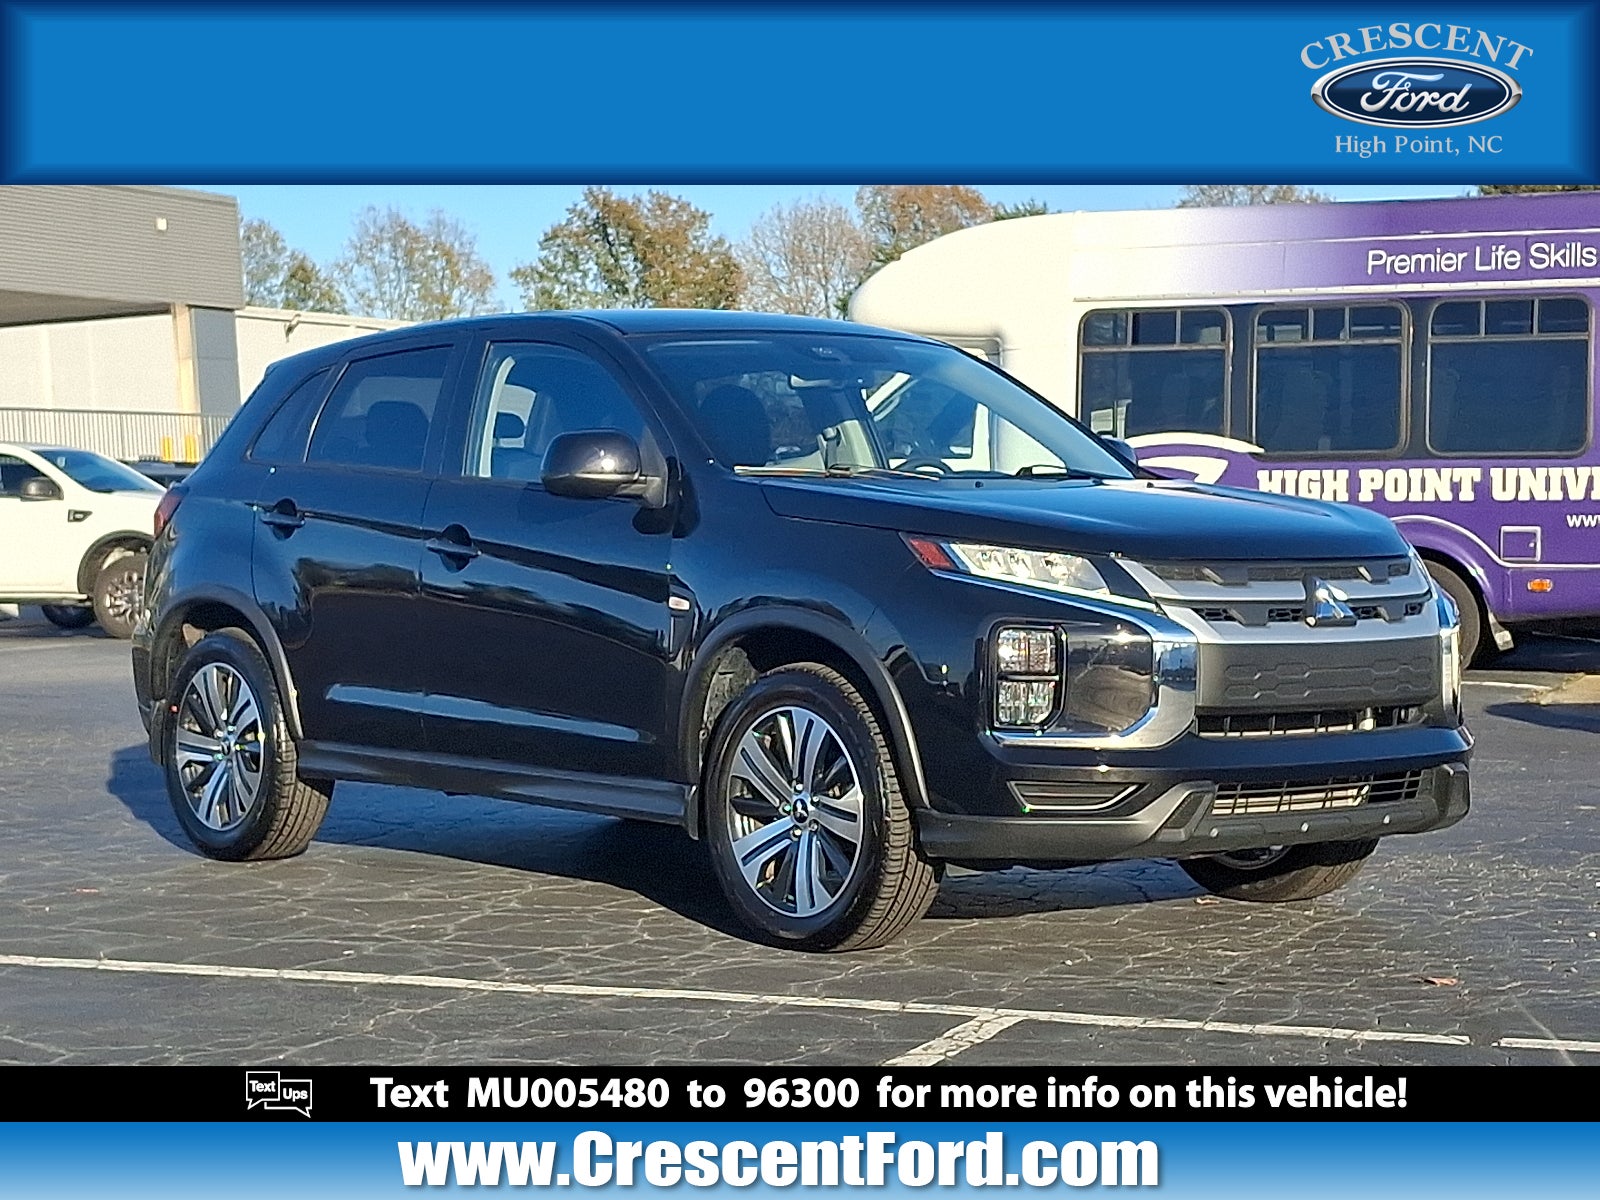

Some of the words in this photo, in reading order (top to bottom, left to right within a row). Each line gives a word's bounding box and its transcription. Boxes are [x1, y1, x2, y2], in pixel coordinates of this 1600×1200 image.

[1367, 248, 1467, 275] Premier
[1474, 245, 1521, 271] Life
[1528, 242, 1598, 269] Skills
[1256, 469, 1349, 502] HIGH
[1358, 467, 1482, 502] POINT
[1566, 514, 1600, 528] ww
